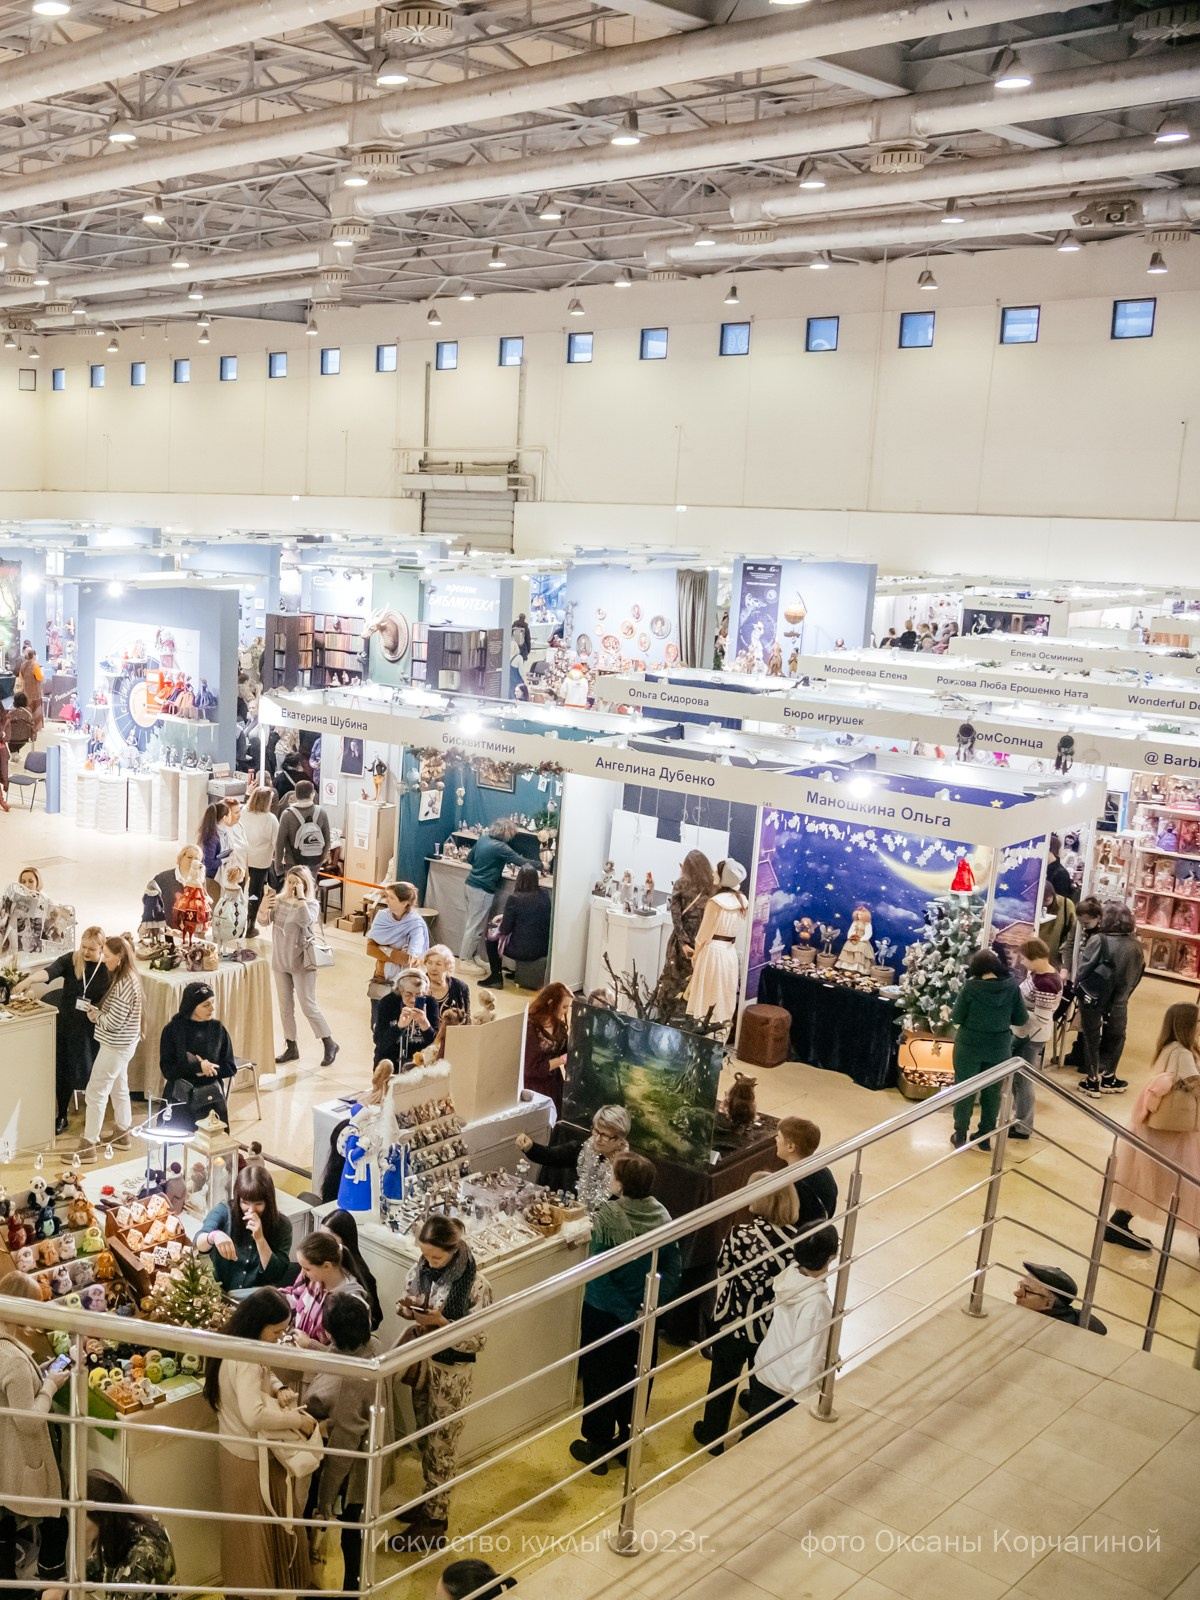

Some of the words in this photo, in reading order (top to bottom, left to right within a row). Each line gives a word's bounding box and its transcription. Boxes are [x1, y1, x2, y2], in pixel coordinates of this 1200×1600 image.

[1010, 649, 1037, 659] Елена
[1039, 651, 1084, 663] Осминина
[823, 664, 877, 678] Молофеева
[879, 668, 908, 681] Елена
[628, 687, 658, 702] Ольга
[660, 692, 709, 707] Сидорова
[979, 677, 1007, 690] Люба
[1010, 683, 1061, 697] Ерошенко
[1063, 688, 1089, 699] Ната
[1127, 694, 1187, 710] Wonderful
[280, 707, 327, 725] Екатерина
[330, 715, 368, 731] Шубина
[783, 706, 814, 721] Бюро
[817, 712, 865, 727] игрушек
[441, 732, 516, 755] бисквитмини
[973, 732, 1044, 750] омСолнца
[1144, 751, 1159, 765] @
[595, 756, 656, 777] Ангелина
[659, 766, 715, 787] Дубенко
[806, 790, 896, 818] Маношкина
[901, 807, 952, 827] Ольга
